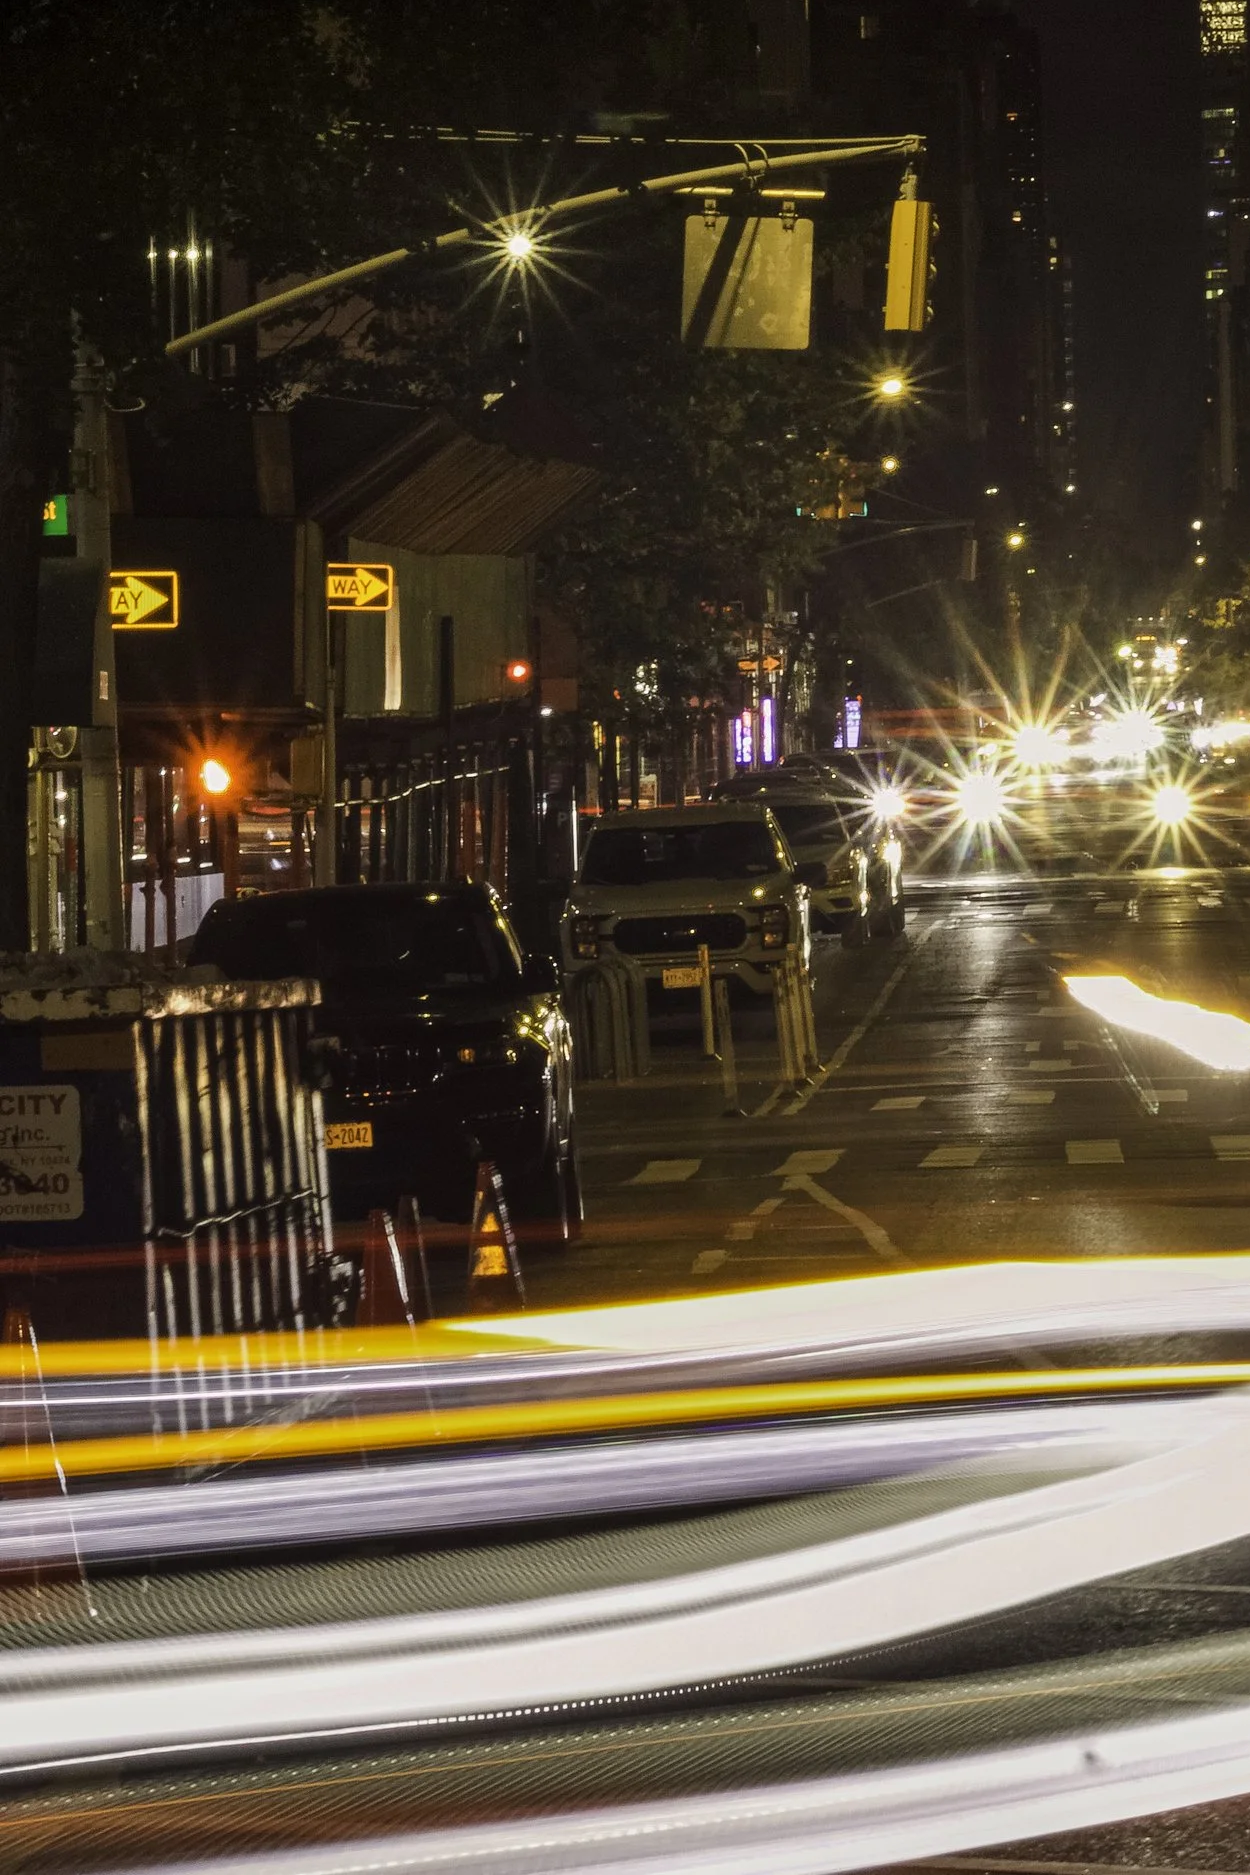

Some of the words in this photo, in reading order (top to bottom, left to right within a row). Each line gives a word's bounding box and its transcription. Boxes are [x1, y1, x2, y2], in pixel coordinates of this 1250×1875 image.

[332, 579, 373, 595] WAY
[114, 590, 144, 610] AY
[0, 1093, 67, 1115] CITY
